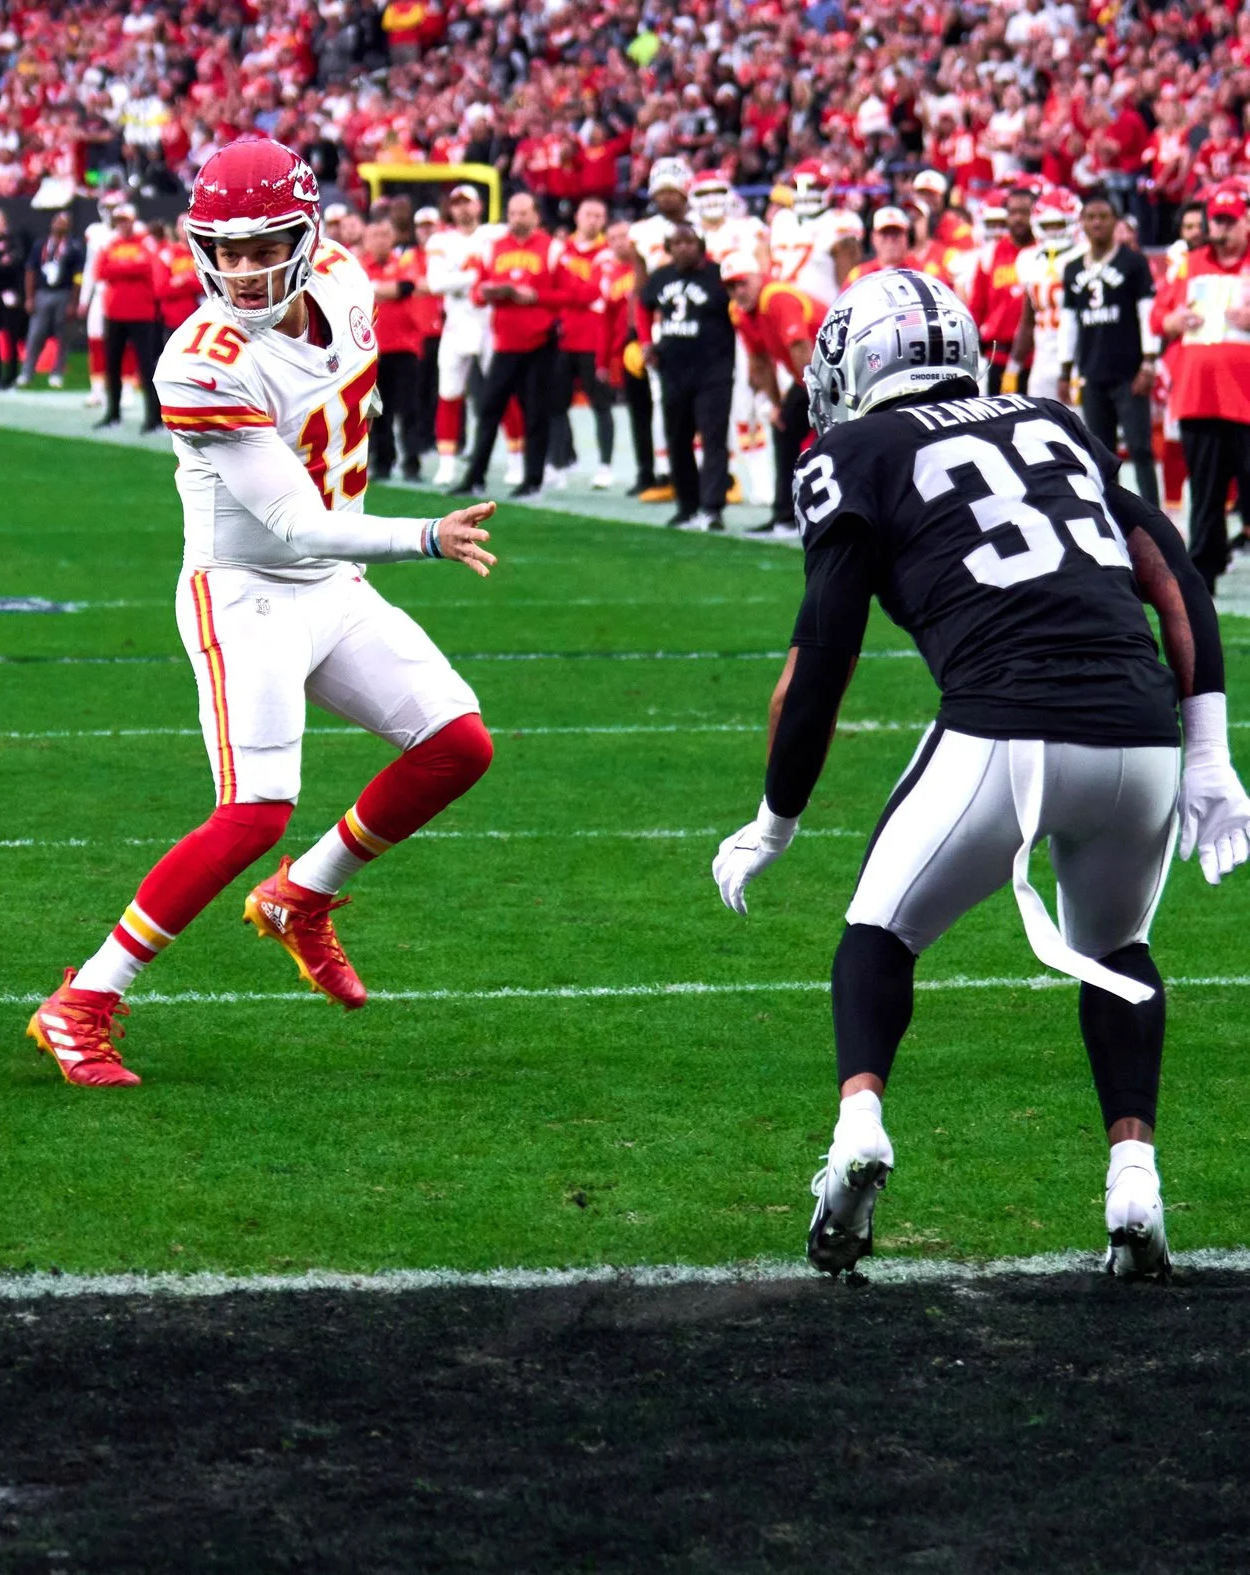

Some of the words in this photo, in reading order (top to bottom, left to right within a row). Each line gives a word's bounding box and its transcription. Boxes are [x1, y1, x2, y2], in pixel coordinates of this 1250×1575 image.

[183, 321, 249, 367] 15
[910, 373, 939, 381] CHOOSE
[296, 355, 378, 512] 15
[912, 418, 1133, 589] 33
